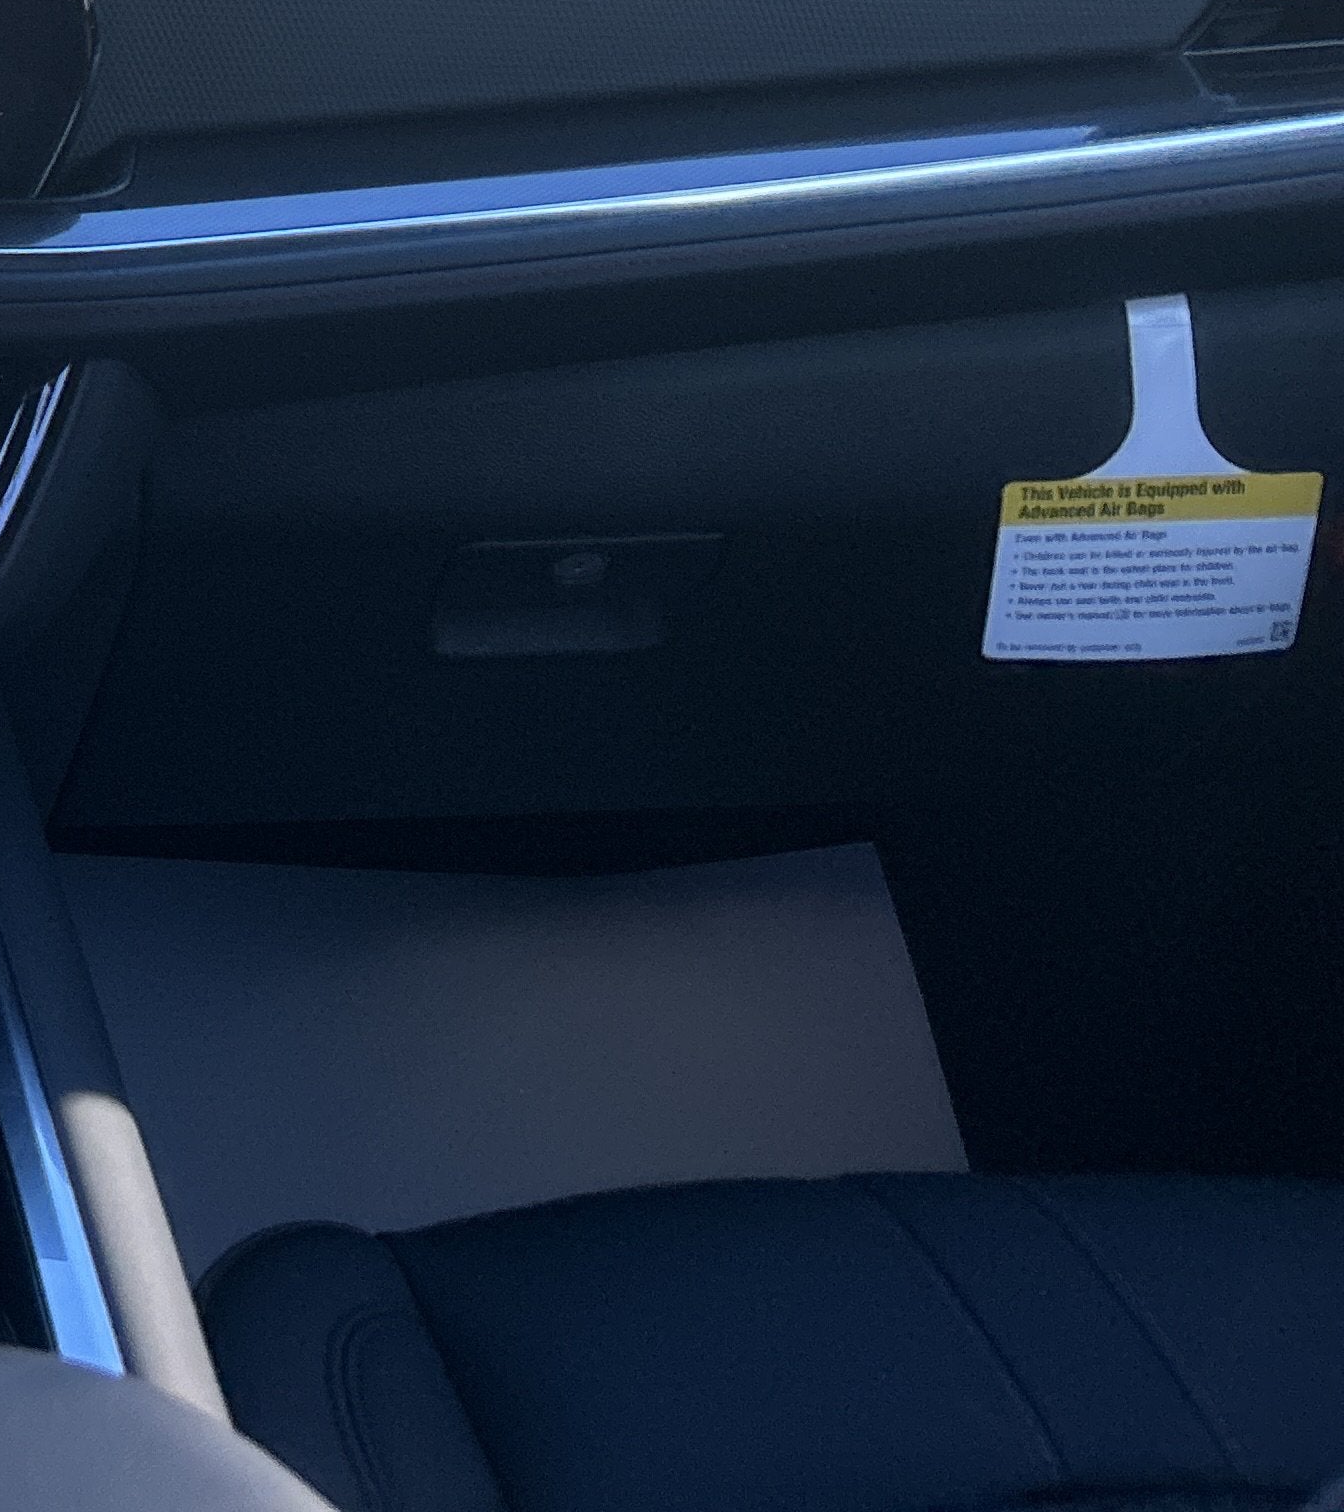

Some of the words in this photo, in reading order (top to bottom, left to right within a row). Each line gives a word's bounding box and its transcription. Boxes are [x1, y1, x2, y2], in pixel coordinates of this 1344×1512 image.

[1022, 487, 1054, 501] This
[1057, 485, 1114, 500] Vehicle
[1118, 484, 1131, 498] is
[1136, 479, 1207, 499] Equipped
[1213, 479, 1246, 496] with
[1018, 504, 1095, 519] Advanced
[1099, 502, 1121, 517] Air
[1126, 501, 1166, 517] Bags
